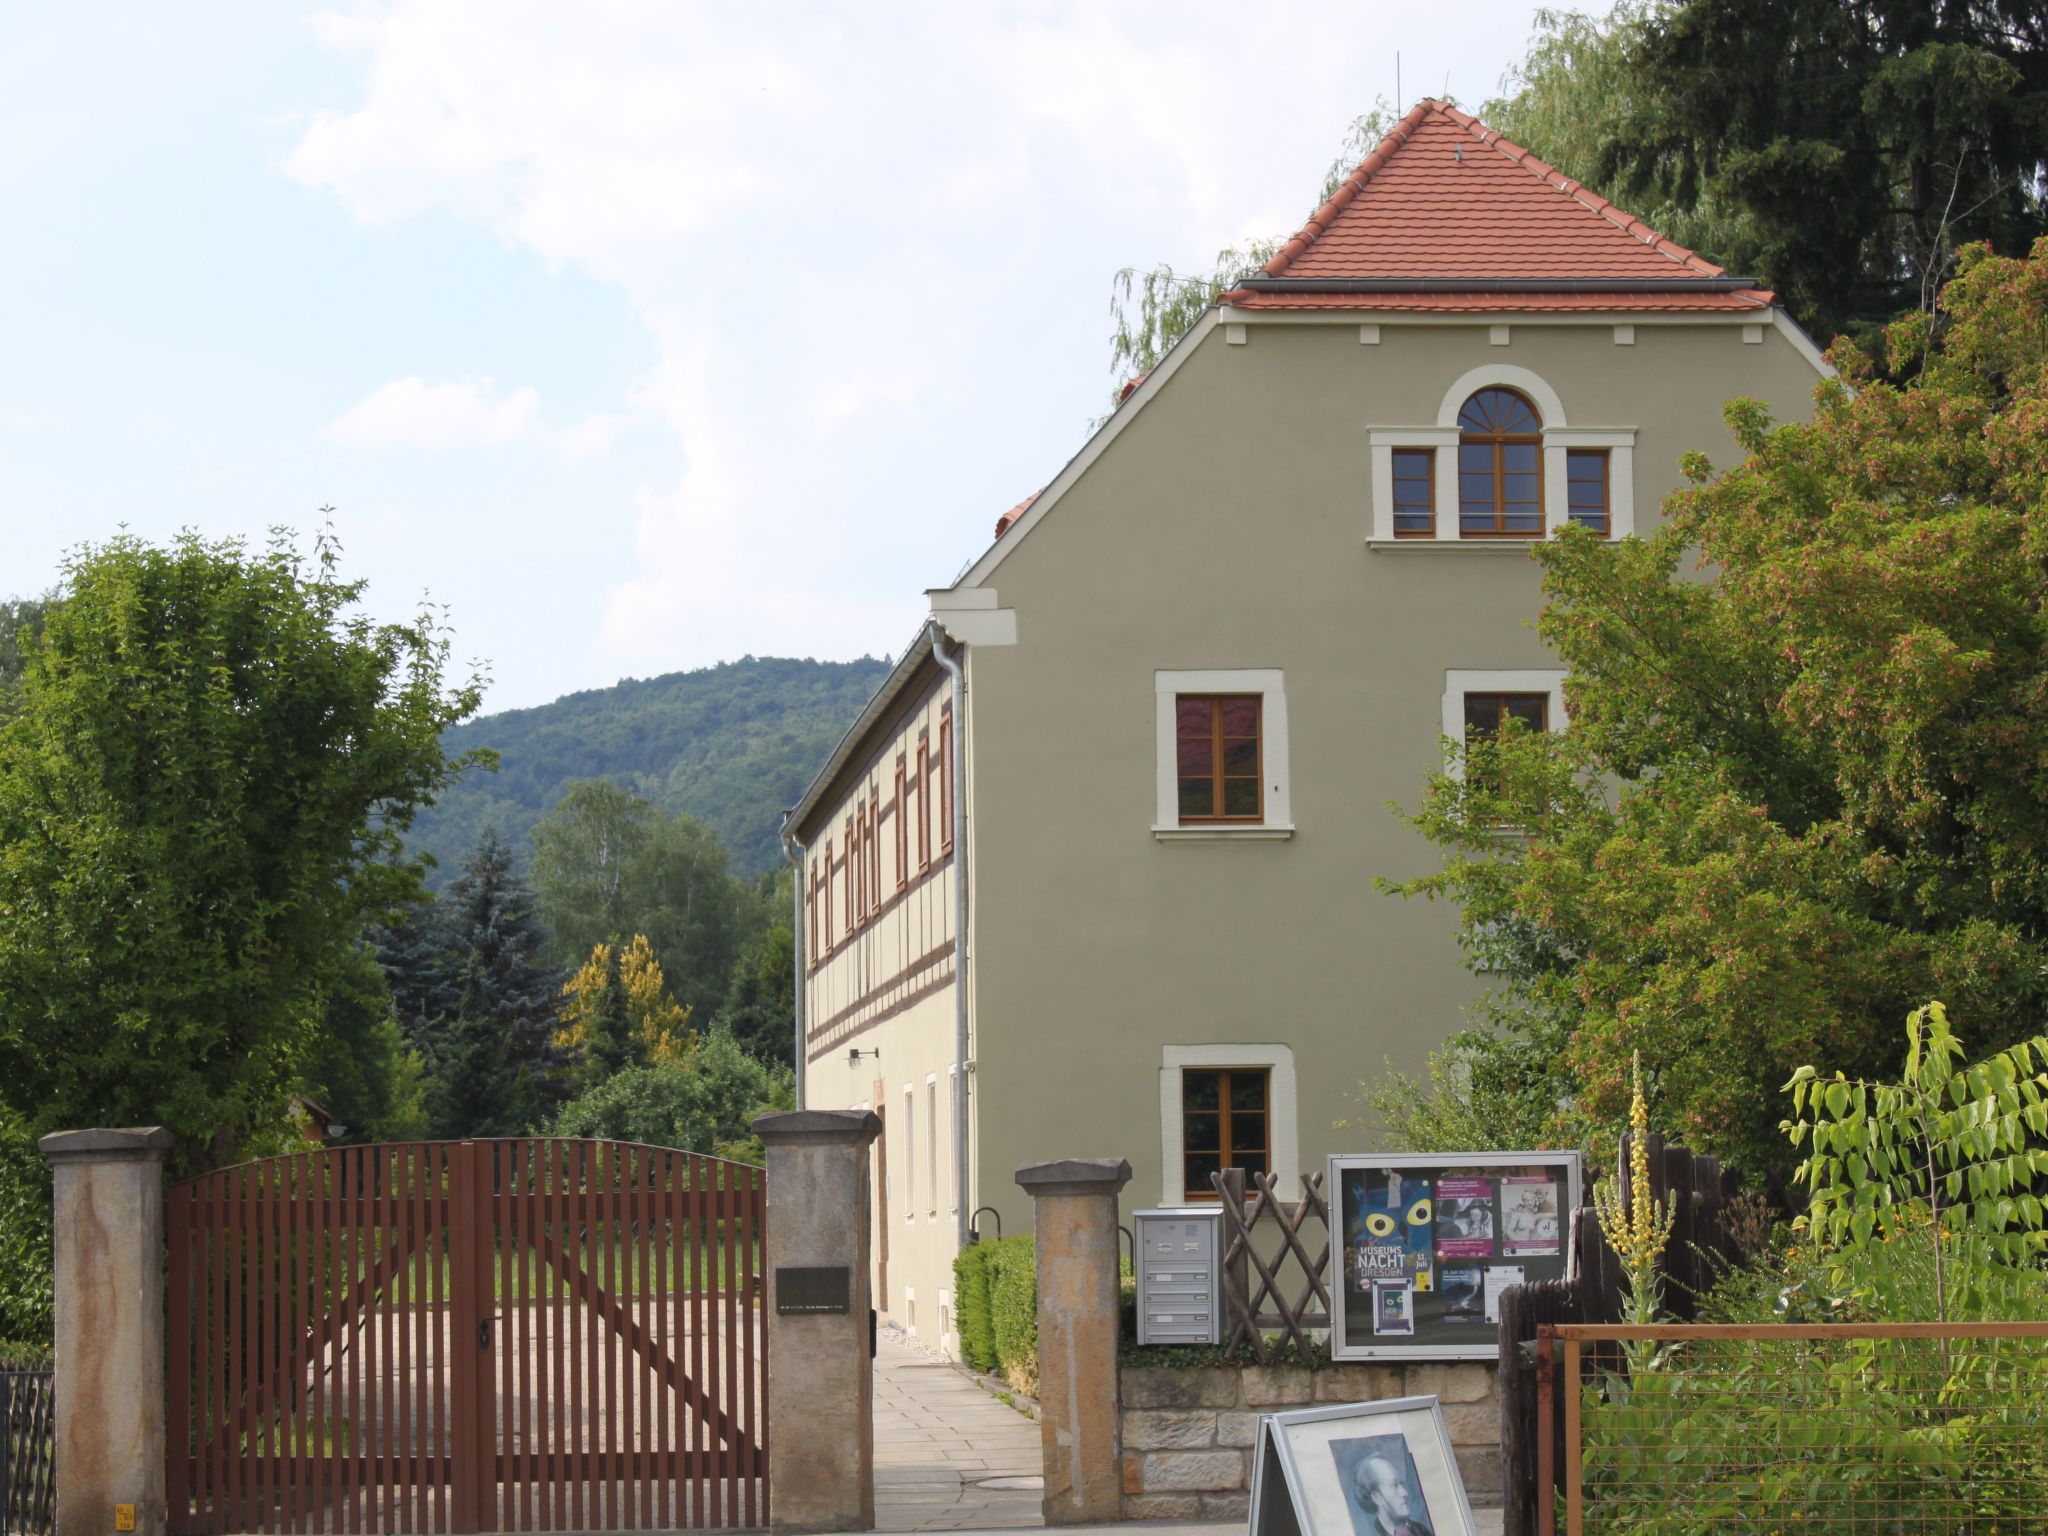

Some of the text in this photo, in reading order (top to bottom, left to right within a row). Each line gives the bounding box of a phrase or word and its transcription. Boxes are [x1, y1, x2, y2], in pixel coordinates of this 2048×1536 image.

[1360, 1246, 1402, 1255] MUSEUMS
[1358, 1254, 1405, 1268] NACHT
[1361, 1268, 1403, 1277] DRESDEN
